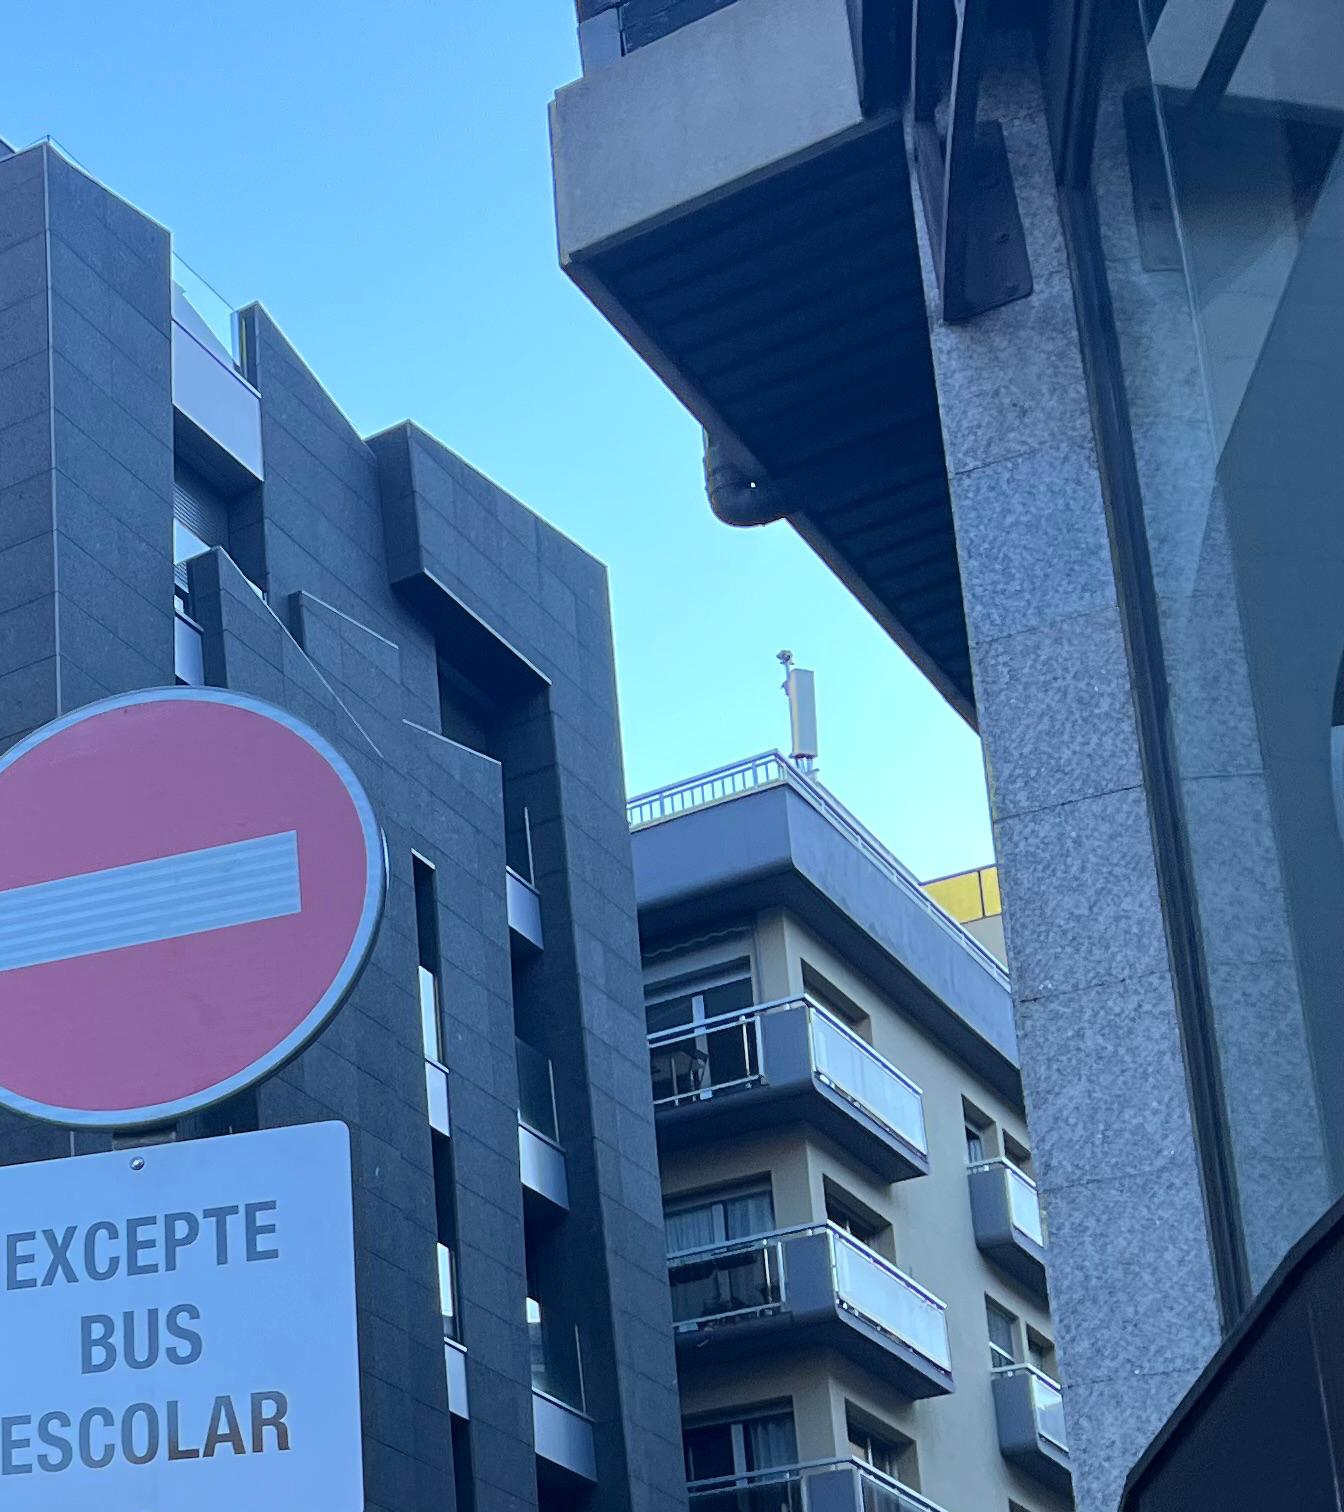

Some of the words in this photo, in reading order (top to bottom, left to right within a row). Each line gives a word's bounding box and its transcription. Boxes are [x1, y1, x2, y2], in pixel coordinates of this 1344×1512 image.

[5, 1199, 280, 1291] EXCEPTE
[80, 1303, 204, 1375] BUS
[0, 1389, 291, 1477] ESCOLAR
